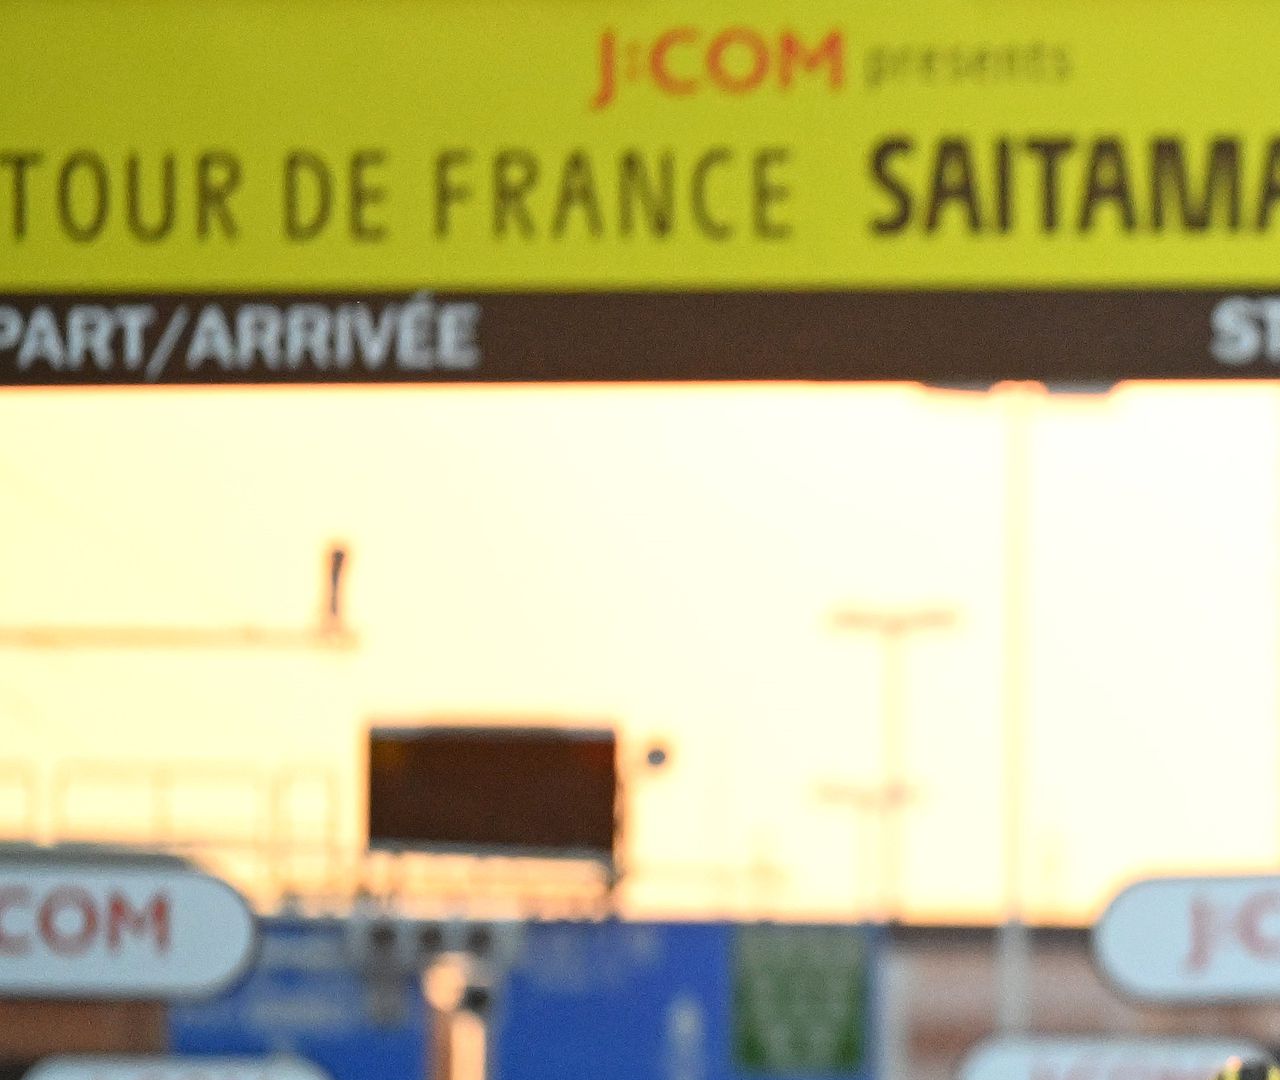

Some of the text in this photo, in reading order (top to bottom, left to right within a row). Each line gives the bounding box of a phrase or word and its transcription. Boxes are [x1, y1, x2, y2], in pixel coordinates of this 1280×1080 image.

[590, 28, 1070, 110] J:COM presents
[0, 149, 243, 244] TOUR
[281, 150, 390, 242] DE
[432, 149, 794, 242] FRANCE
